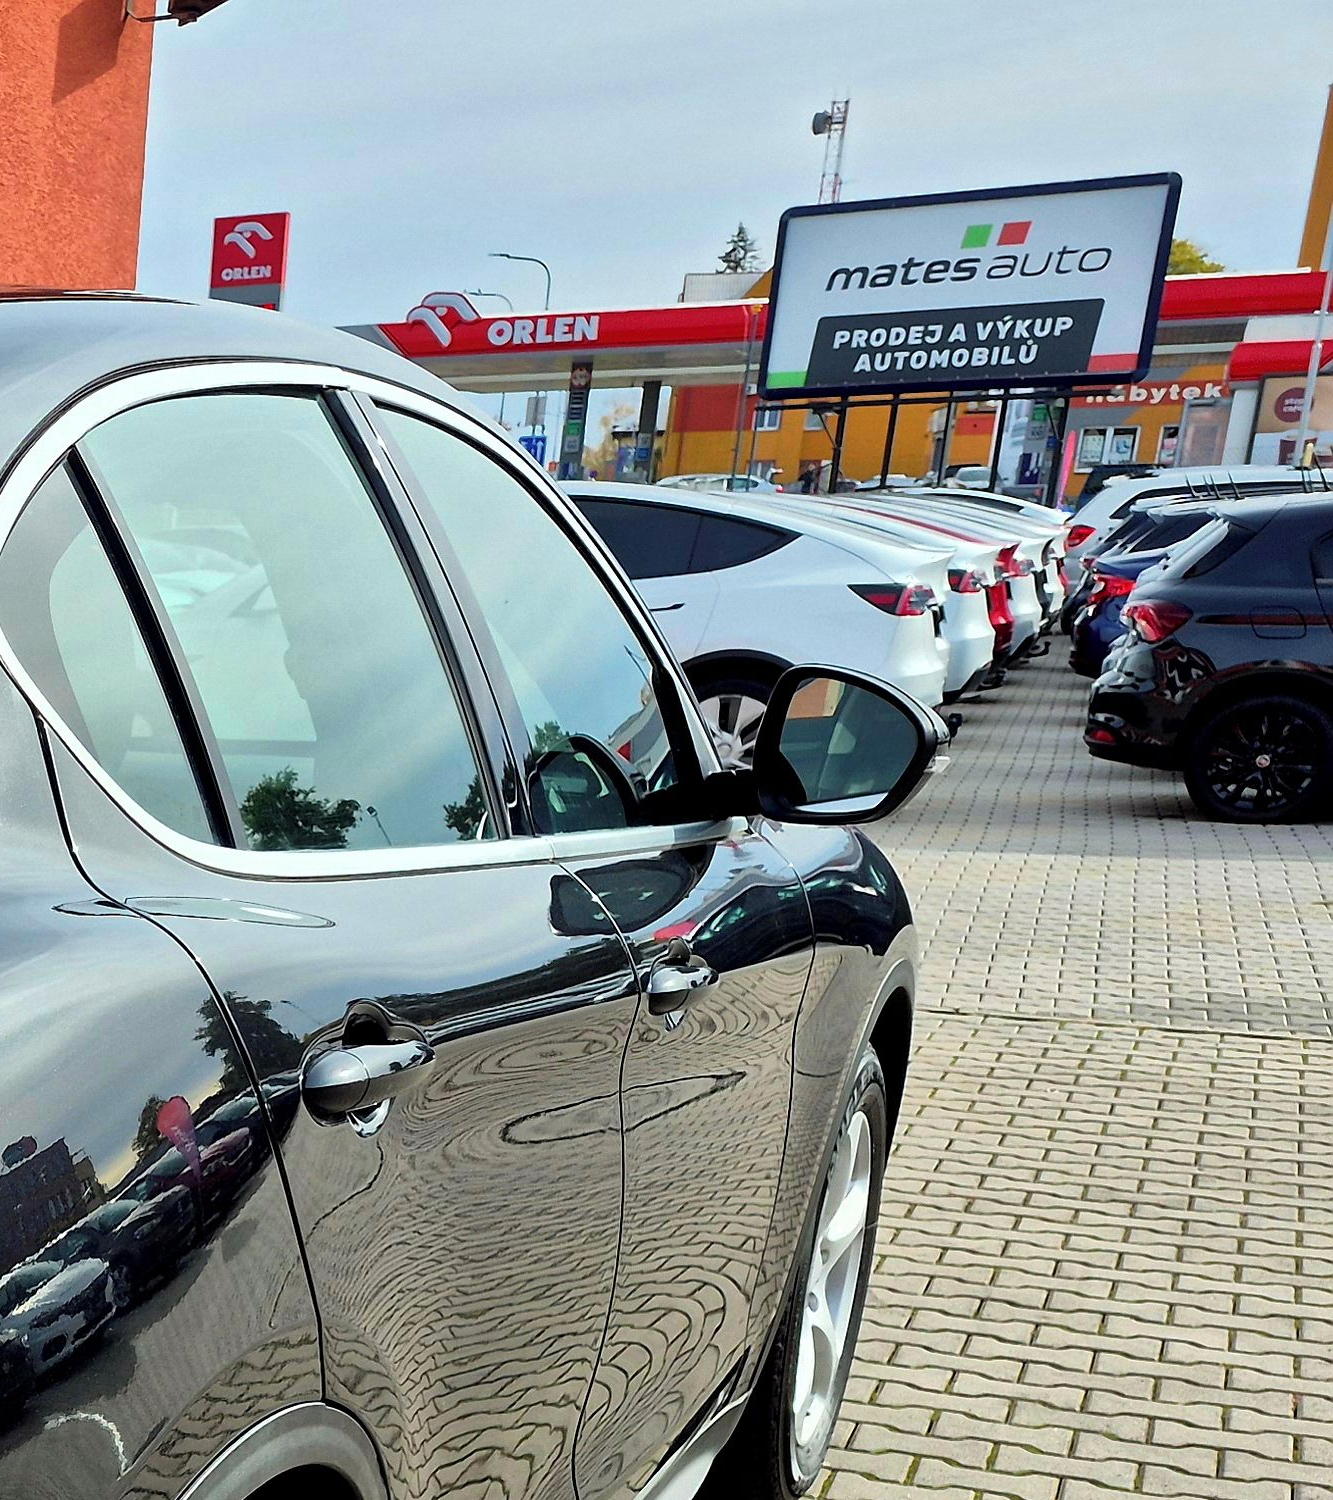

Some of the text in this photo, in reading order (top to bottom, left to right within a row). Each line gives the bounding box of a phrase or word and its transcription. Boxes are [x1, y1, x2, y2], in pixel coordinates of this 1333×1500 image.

[221, 264, 272, 282] ORLEN
[825, 244, 1113, 292] mates auto
[486, 314, 600, 347] ORLEN
[832, 314, 1075, 351] PRODEJ A VÝKUP
[853, 339, 1039, 374] AUTOMOBILŮ
